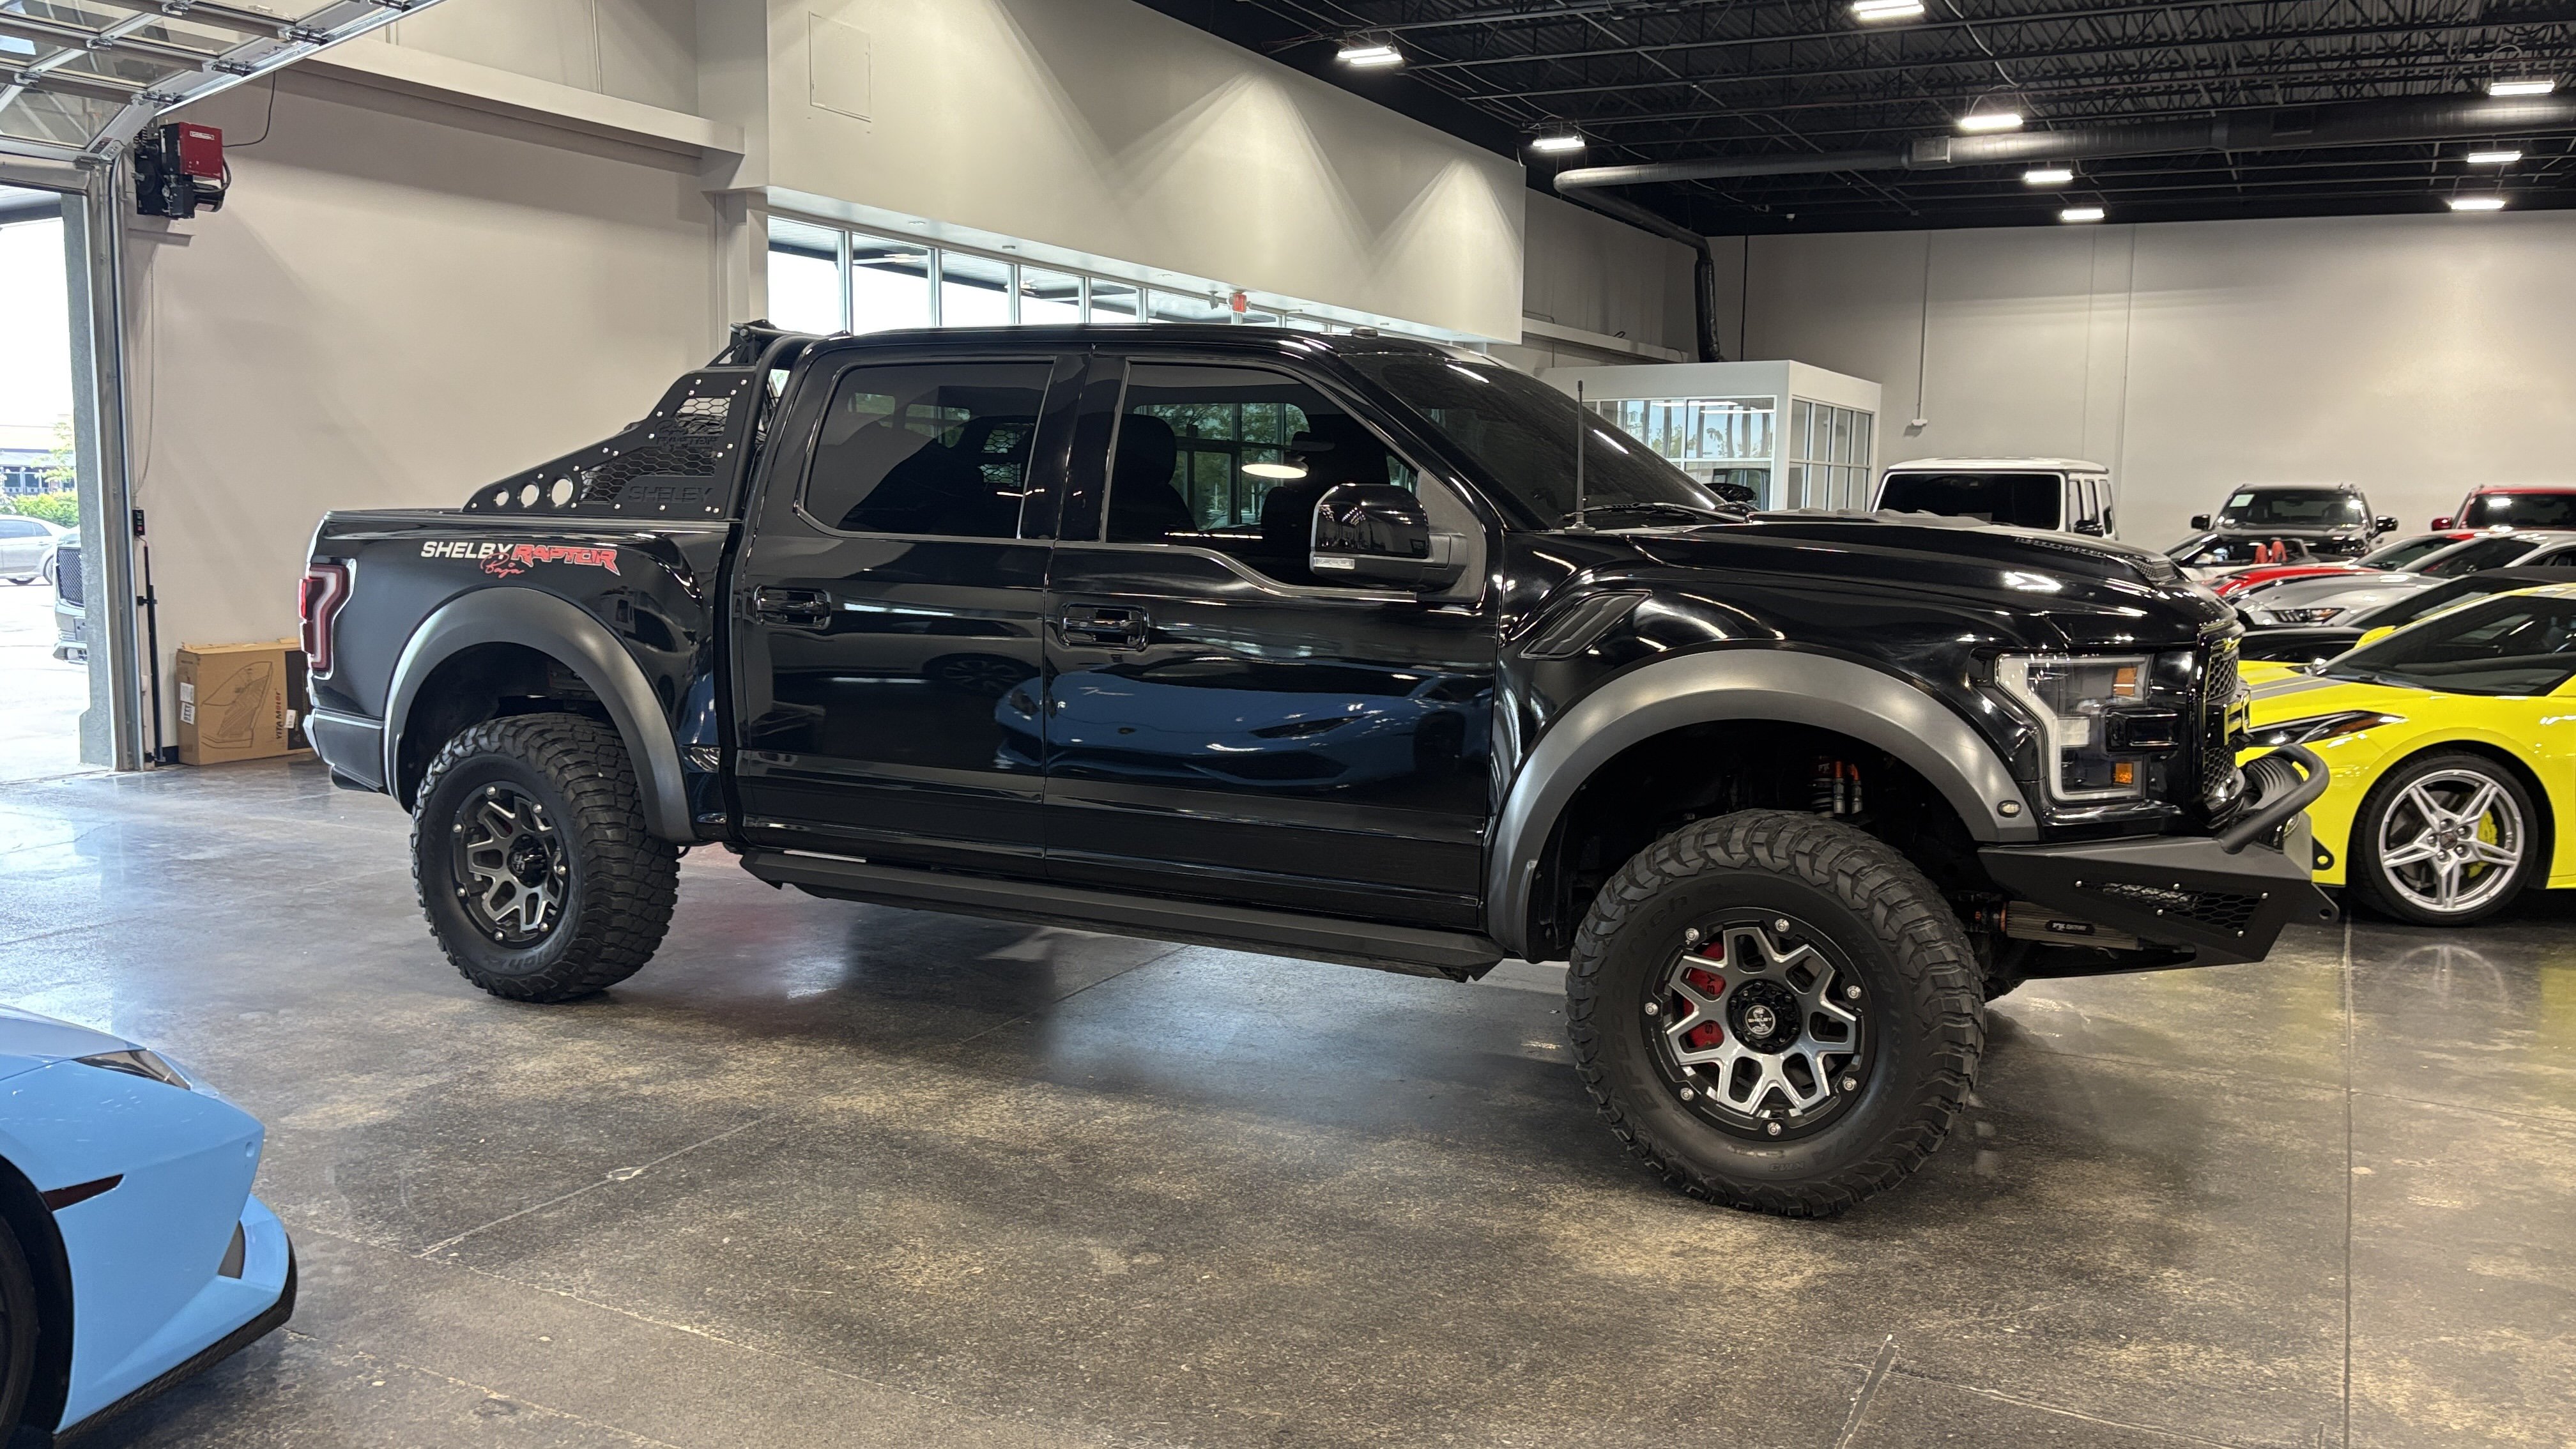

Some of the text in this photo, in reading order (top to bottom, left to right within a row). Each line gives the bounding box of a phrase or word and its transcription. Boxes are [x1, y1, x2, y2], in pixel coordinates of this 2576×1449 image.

[629, 486, 714, 503] SHELBY
[420, 541, 621, 576] SHELBY RAPTOR
[480, 553, 525, 578] Baja
